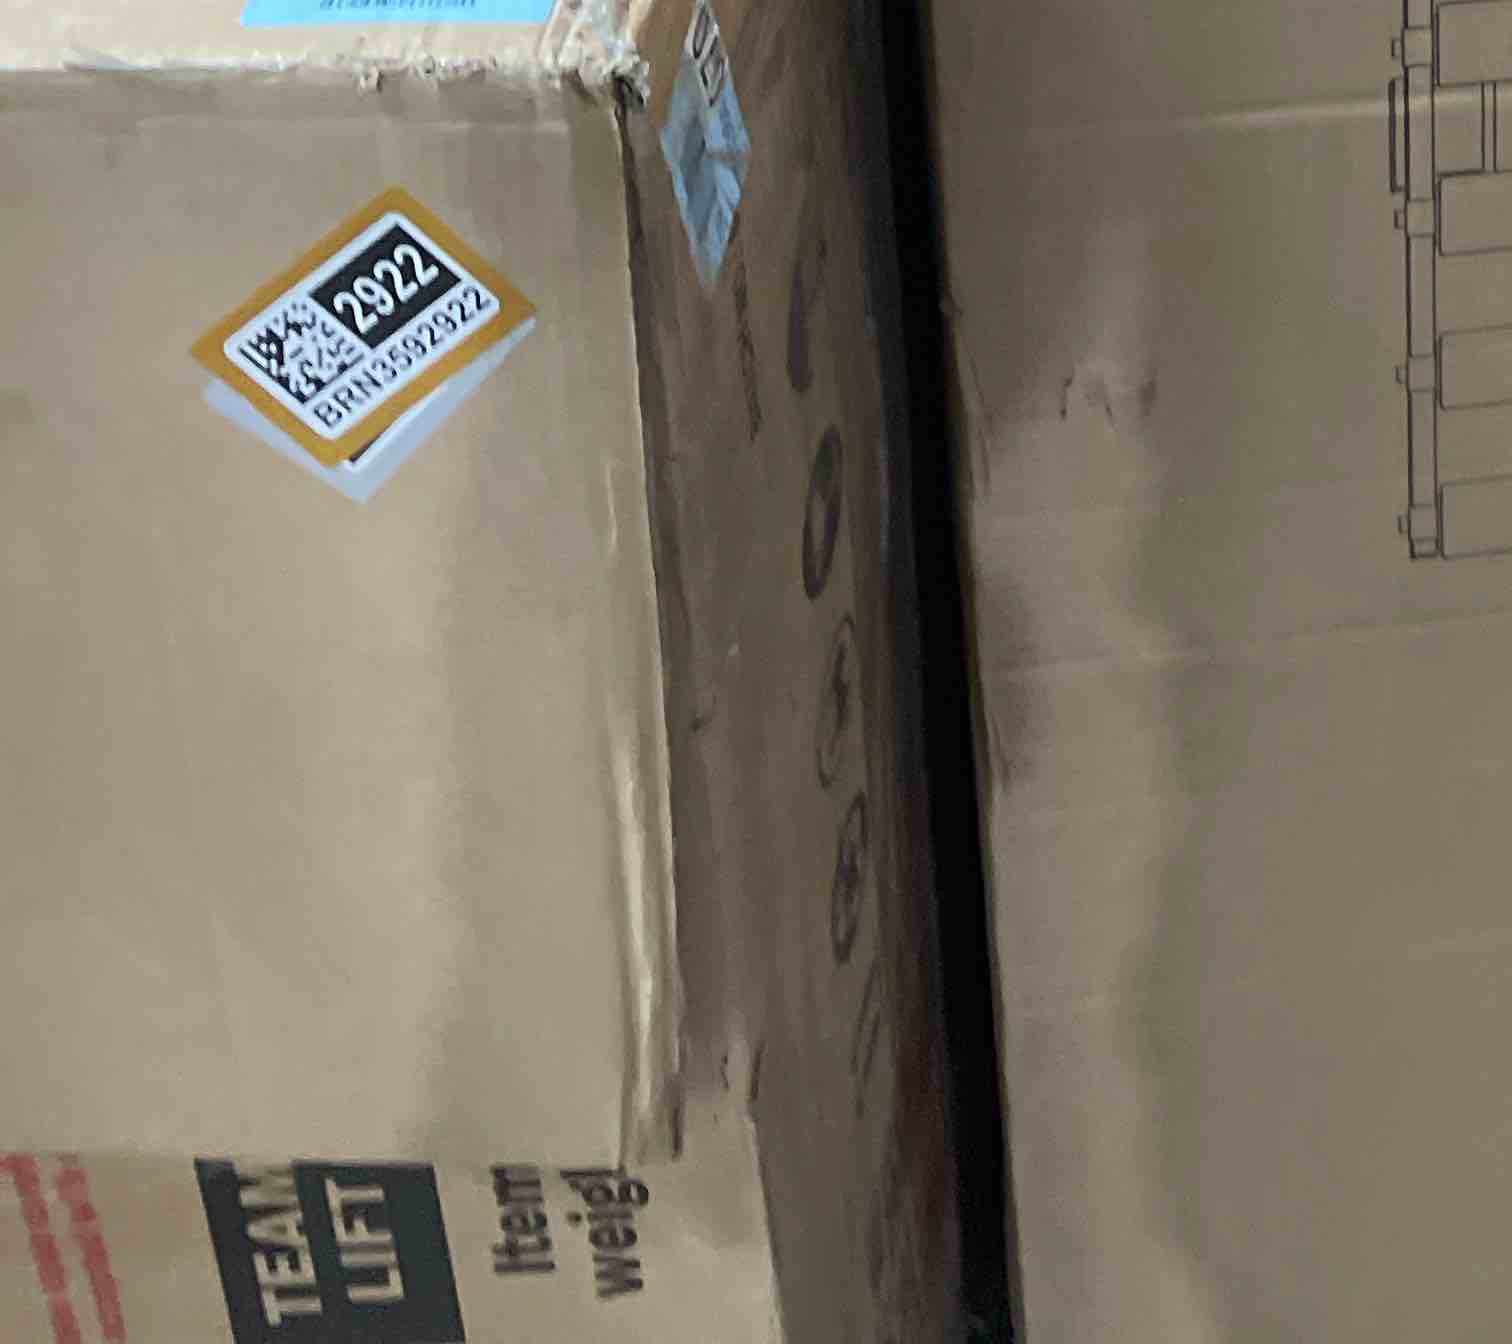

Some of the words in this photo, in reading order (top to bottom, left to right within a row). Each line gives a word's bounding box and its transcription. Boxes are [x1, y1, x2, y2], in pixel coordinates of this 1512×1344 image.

[332, 240, 440, 336] 2922
[312, 285, 493, 430] BRN3592922
[238, 1167, 323, 1328] TEAM
[325, 1177, 404, 1305] LIFT
[491, 1165, 556, 1274] Item
